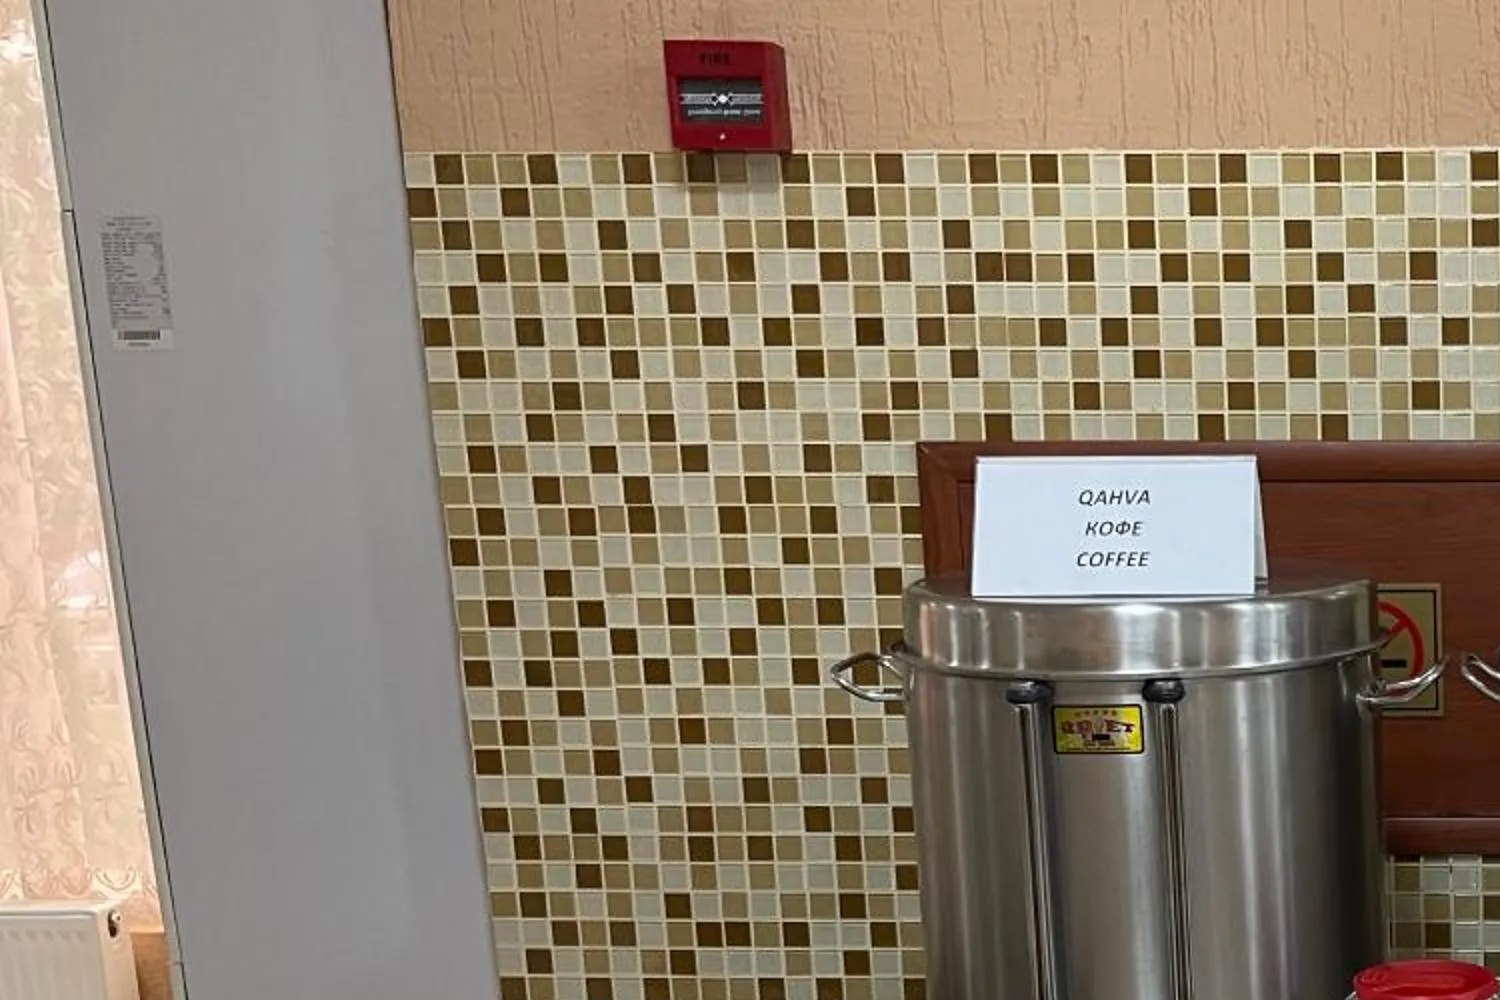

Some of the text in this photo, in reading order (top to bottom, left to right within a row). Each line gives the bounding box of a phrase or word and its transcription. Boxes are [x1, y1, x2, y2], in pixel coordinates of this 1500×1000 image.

[1078, 489, 1151, 507] QAHVA
[1085, 521, 1144, 537] КОФЕ
[1076, 552, 1150, 568] COFFEE
